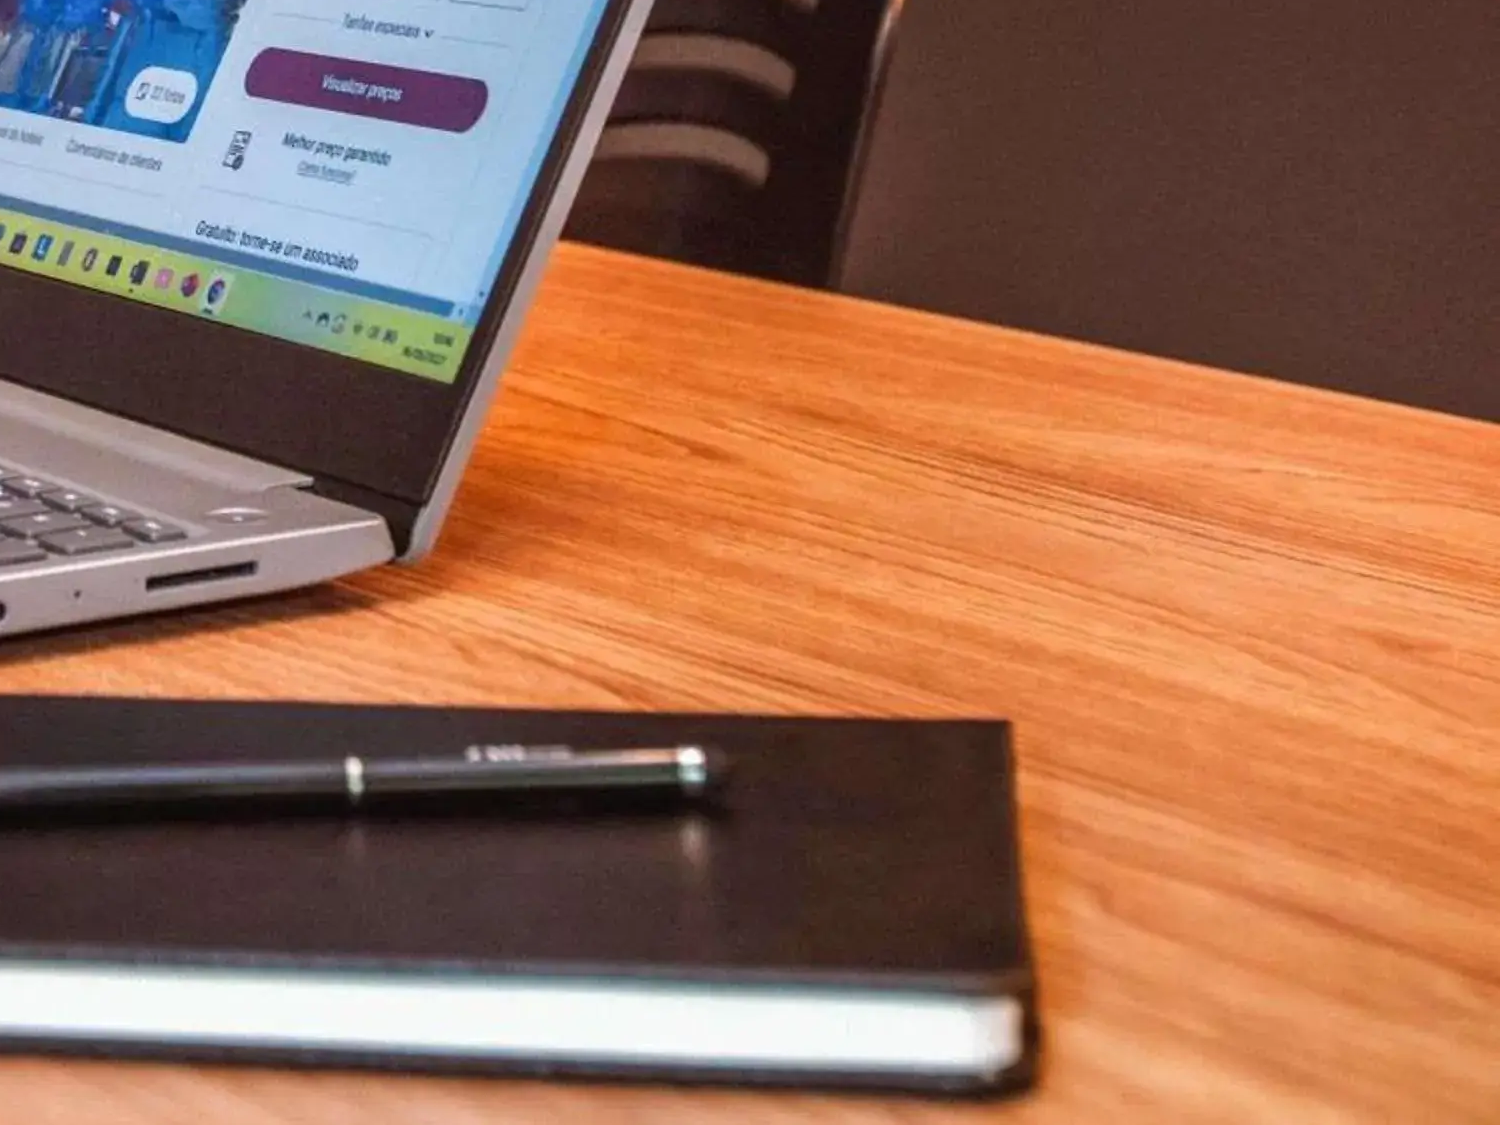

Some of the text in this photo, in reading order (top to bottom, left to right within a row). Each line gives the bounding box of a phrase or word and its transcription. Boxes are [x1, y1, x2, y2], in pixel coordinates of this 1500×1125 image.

[322, 74, 404, 103] Visualizar preços
[281, 131, 392, 166] Melhor preço garantido
[239, 233, 284, 253] torne-se
[283, 243, 302, 258] um
[303, 246, 359, 272] associado
